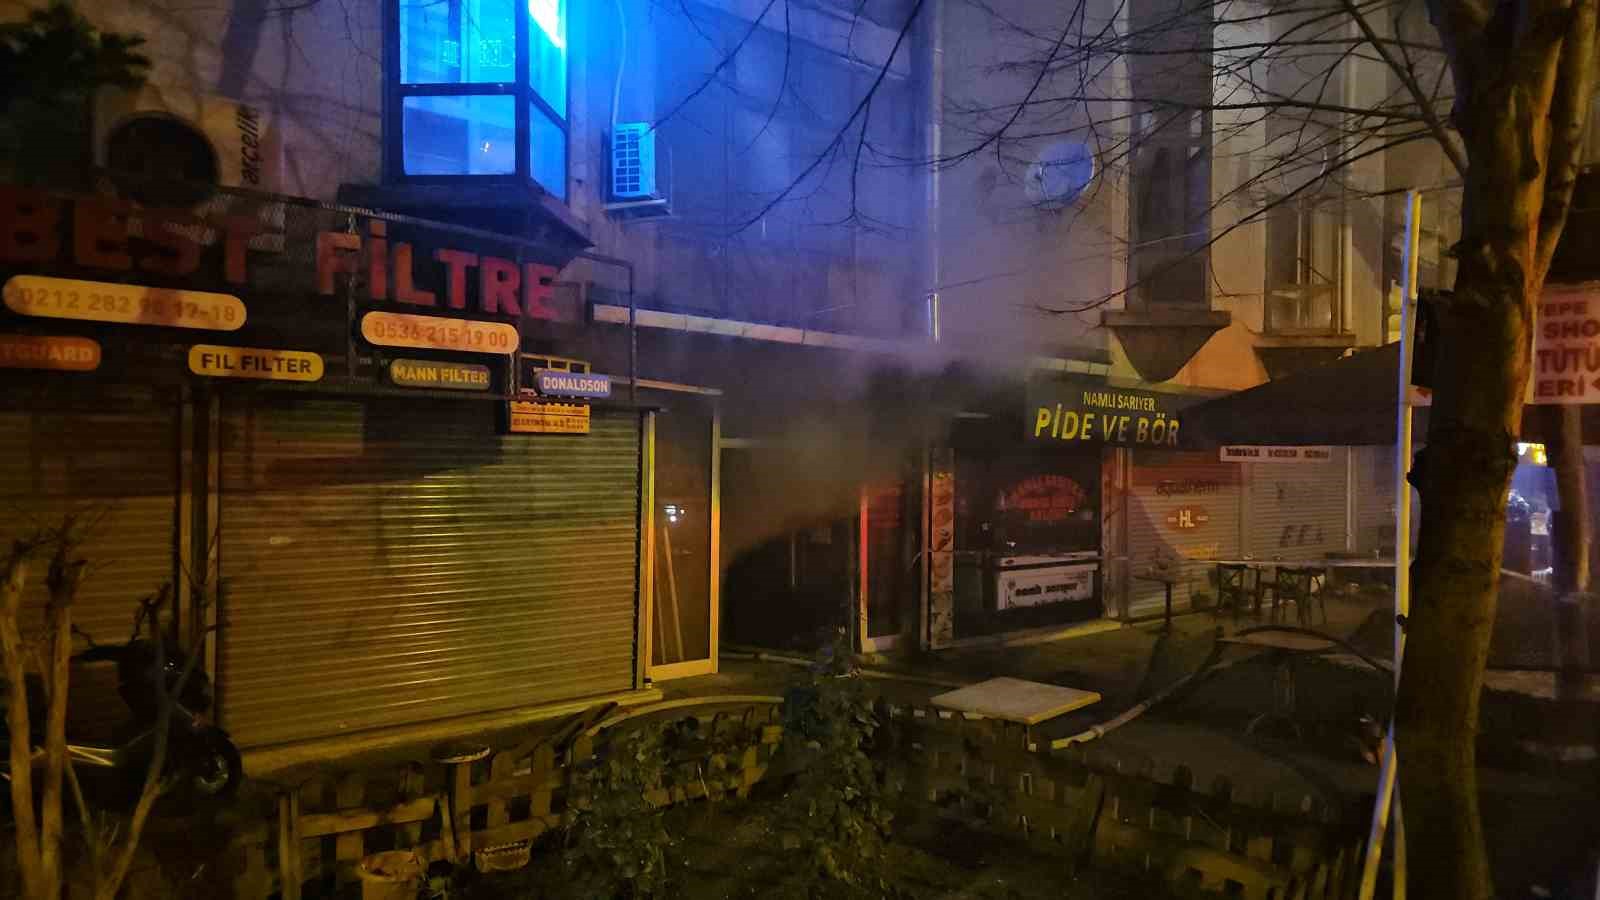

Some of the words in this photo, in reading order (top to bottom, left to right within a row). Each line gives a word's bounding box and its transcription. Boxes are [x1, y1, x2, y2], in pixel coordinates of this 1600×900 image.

[0, 188, 258, 285] BEST
[317, 217, 558, 319] FİLTRE
[487, 331, 508, 348] 00
[202, 353, 234, 371] FIL
[241, 355, 313, 376] FILTER
[392, 366, 437, 382] MANN
[440, 368, 489, 385] FILTER
[543, 376, 609, 393] DONALDSON
[1082, 392, 1115, 409] NAMLI
[1117, 393, 1156, 411] SARIYER
[1034, 402, 1096, 441] PİDE
[1103, 414, 1131, 442] VE
[1136, 412, 1181, 447] BÖR
